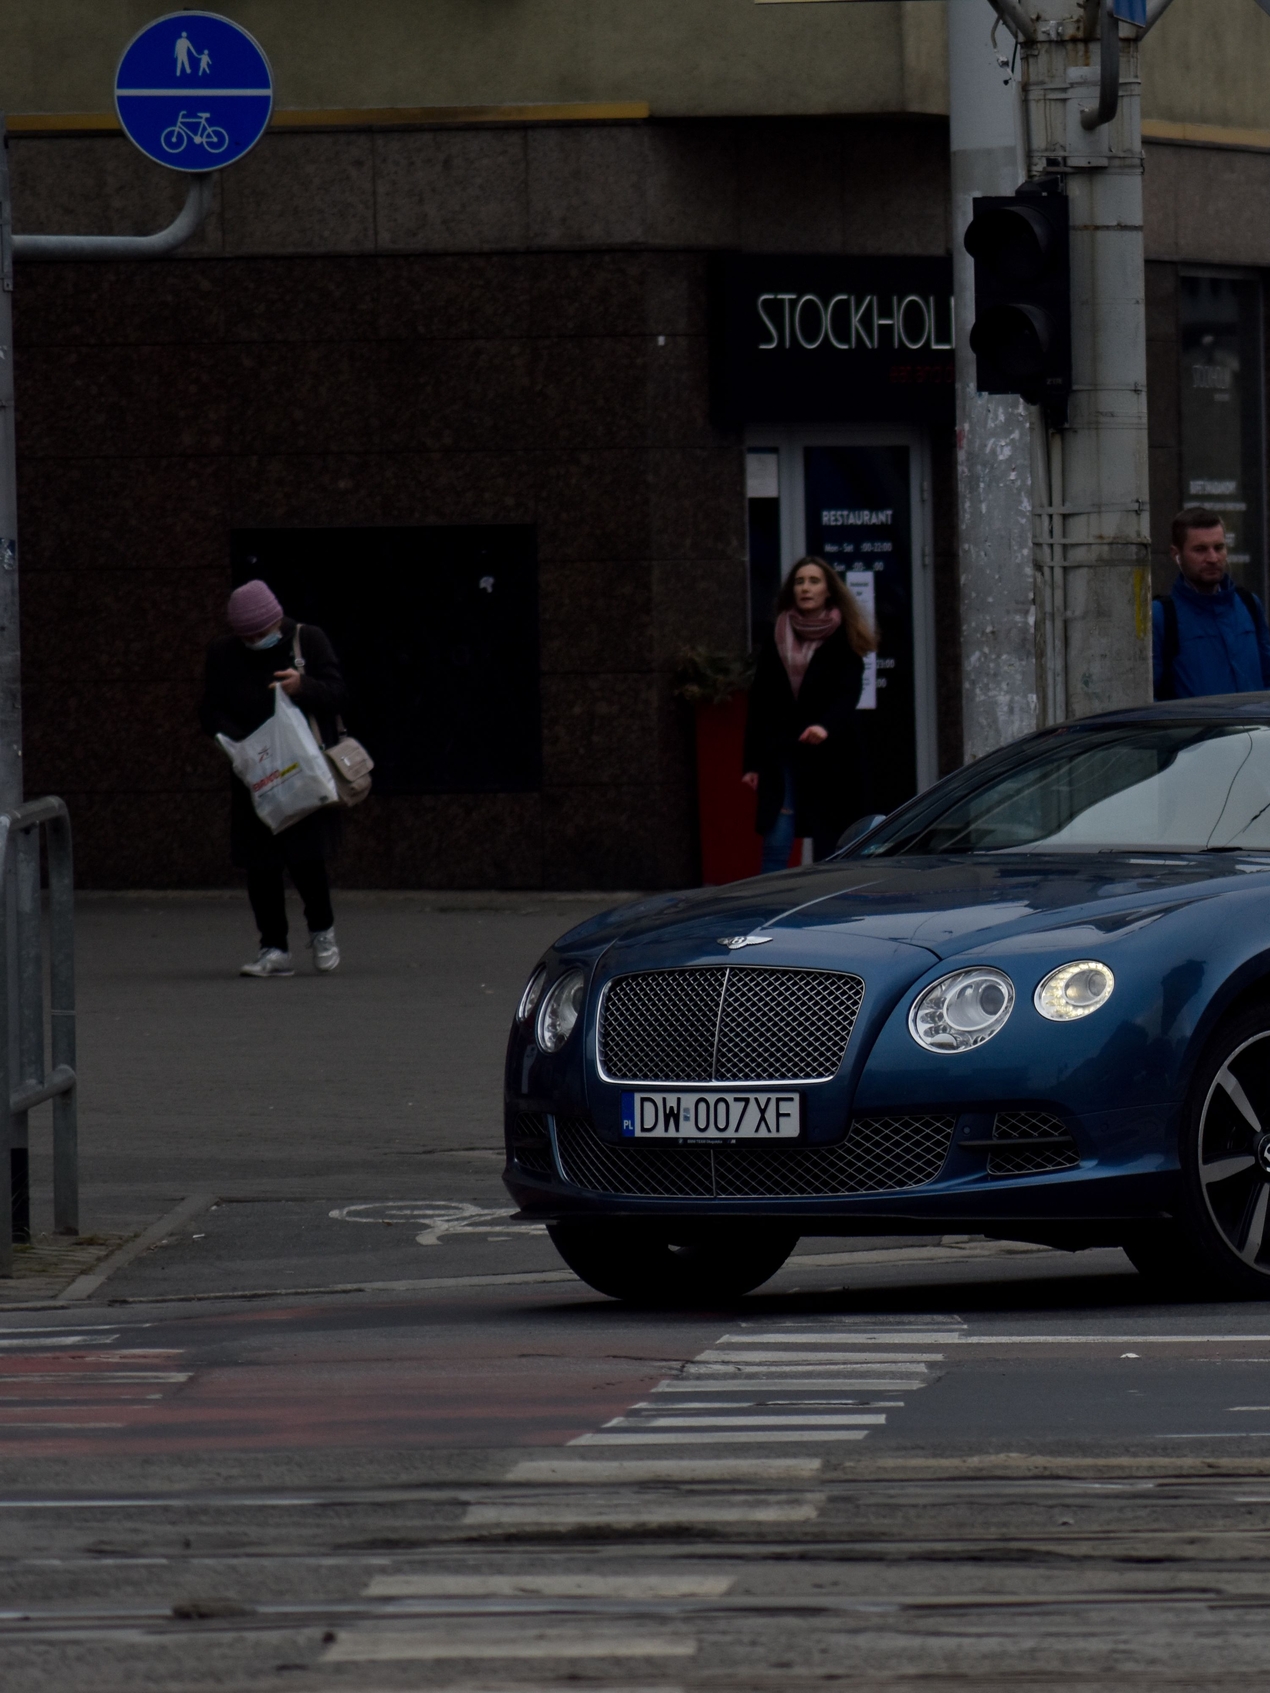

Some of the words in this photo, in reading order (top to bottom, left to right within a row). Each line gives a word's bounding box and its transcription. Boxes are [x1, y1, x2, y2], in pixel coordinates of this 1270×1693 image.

[757, 294, 955, 350] STOCKHOL
[822, 509, 893, 526] RESTAURANT
[623, 1119, 634, 1131] PL
[640, 1096, 681, 1133] DW
[694, 1096, 794, 1133] 007XF
